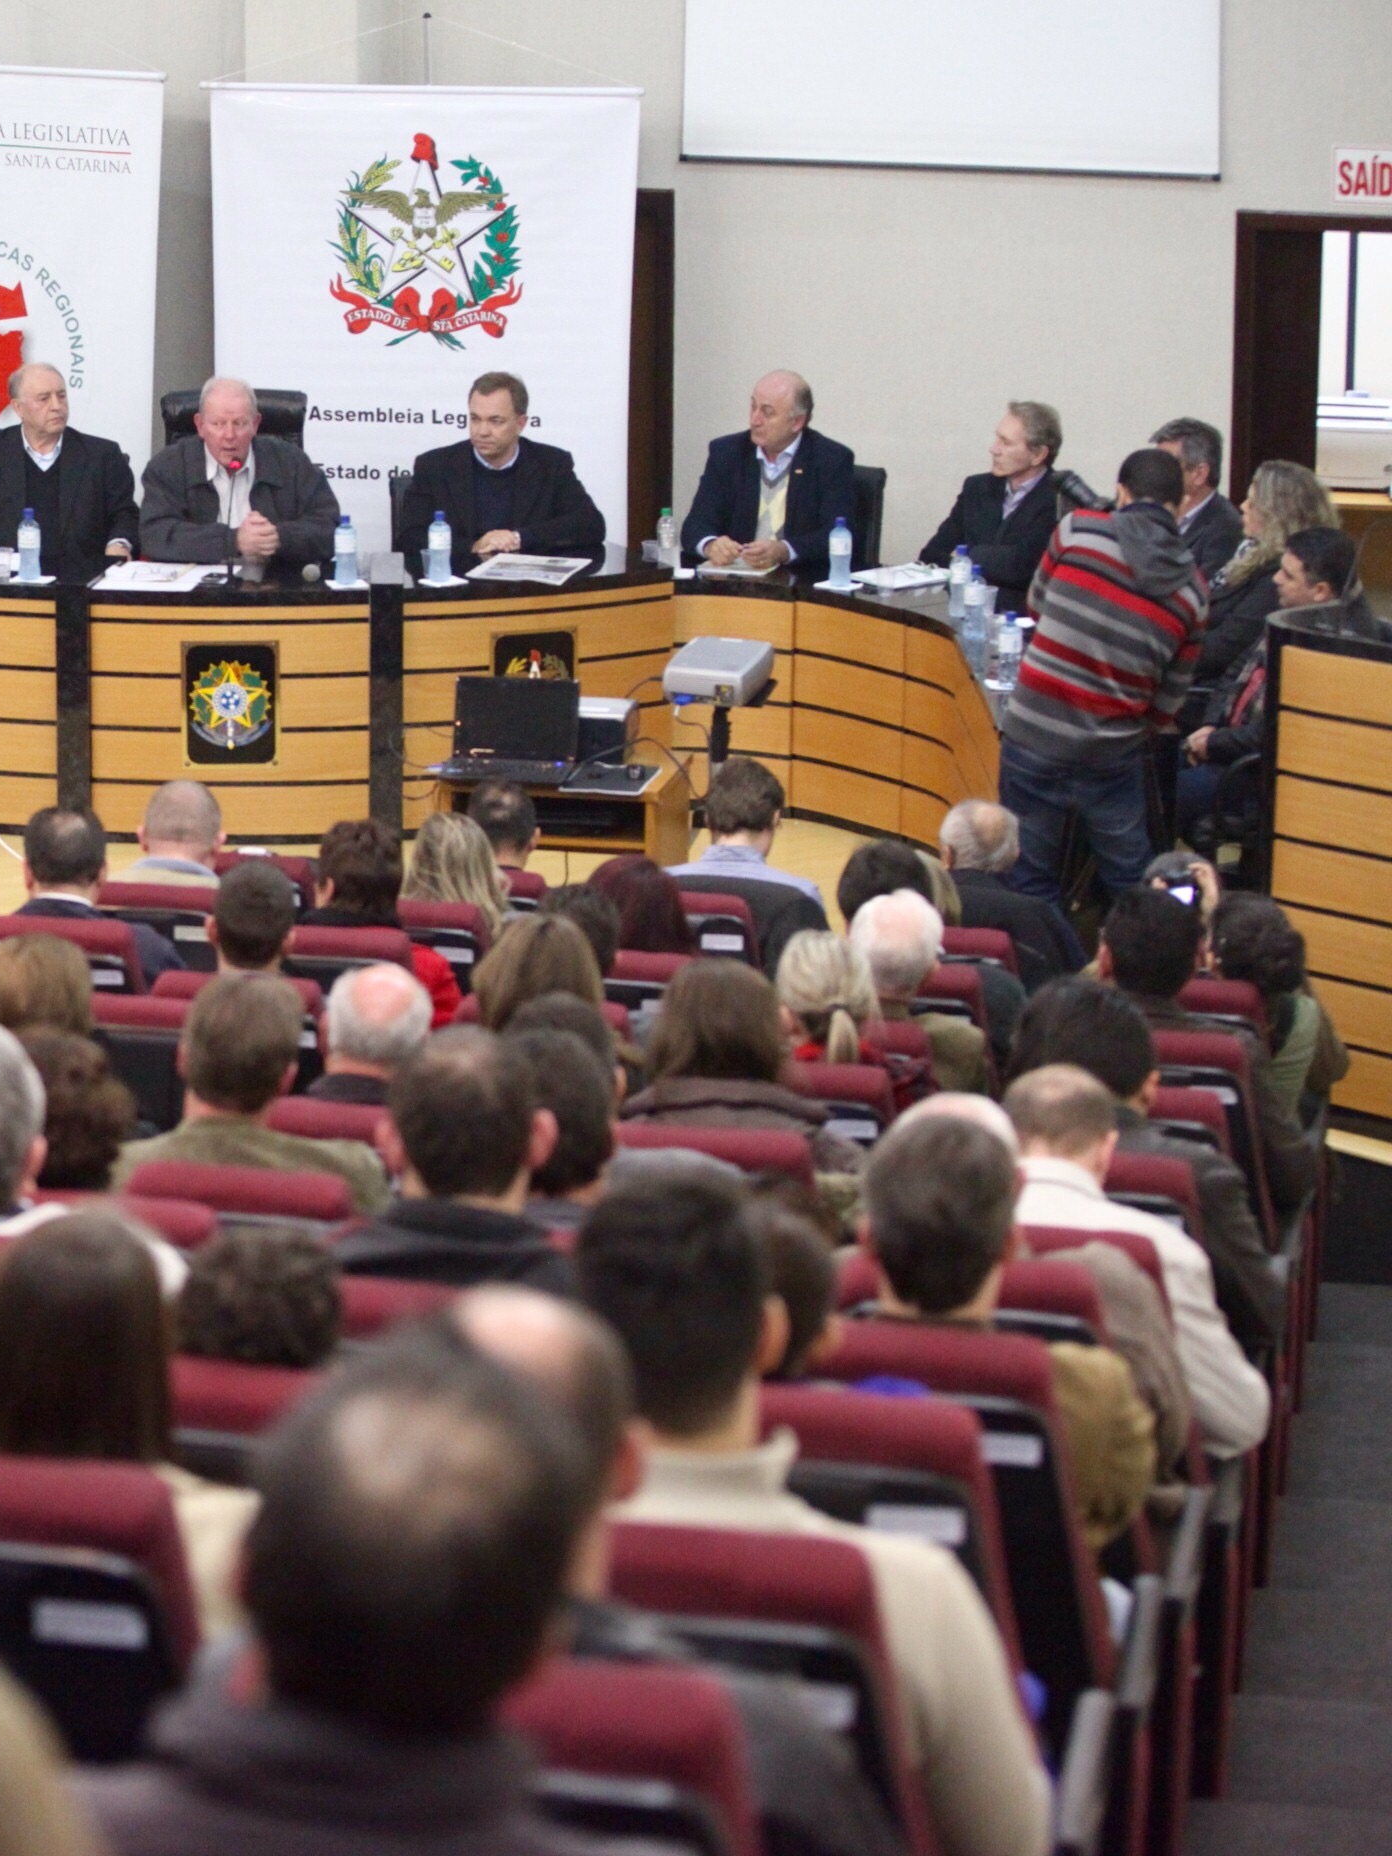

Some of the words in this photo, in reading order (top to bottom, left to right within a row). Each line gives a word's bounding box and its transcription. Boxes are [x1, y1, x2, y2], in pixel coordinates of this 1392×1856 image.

[13, 122, 131, 146] LEGISLATIVA
[5, 152, 52, 170] SANTA
[55, 156, 131, 174] CATARINA
[1338, 155, 1392, 196] SAÍD
[35, 267, 85, 389] REGIONAIS
[347, 309, 391, 323] ESTADO
[392, 315, 410, 329] DE
[456, 310, 504, 327] CATARINA
[308, 405, 424, 424] Assembleia
[311, 463, 381, 480] stado
